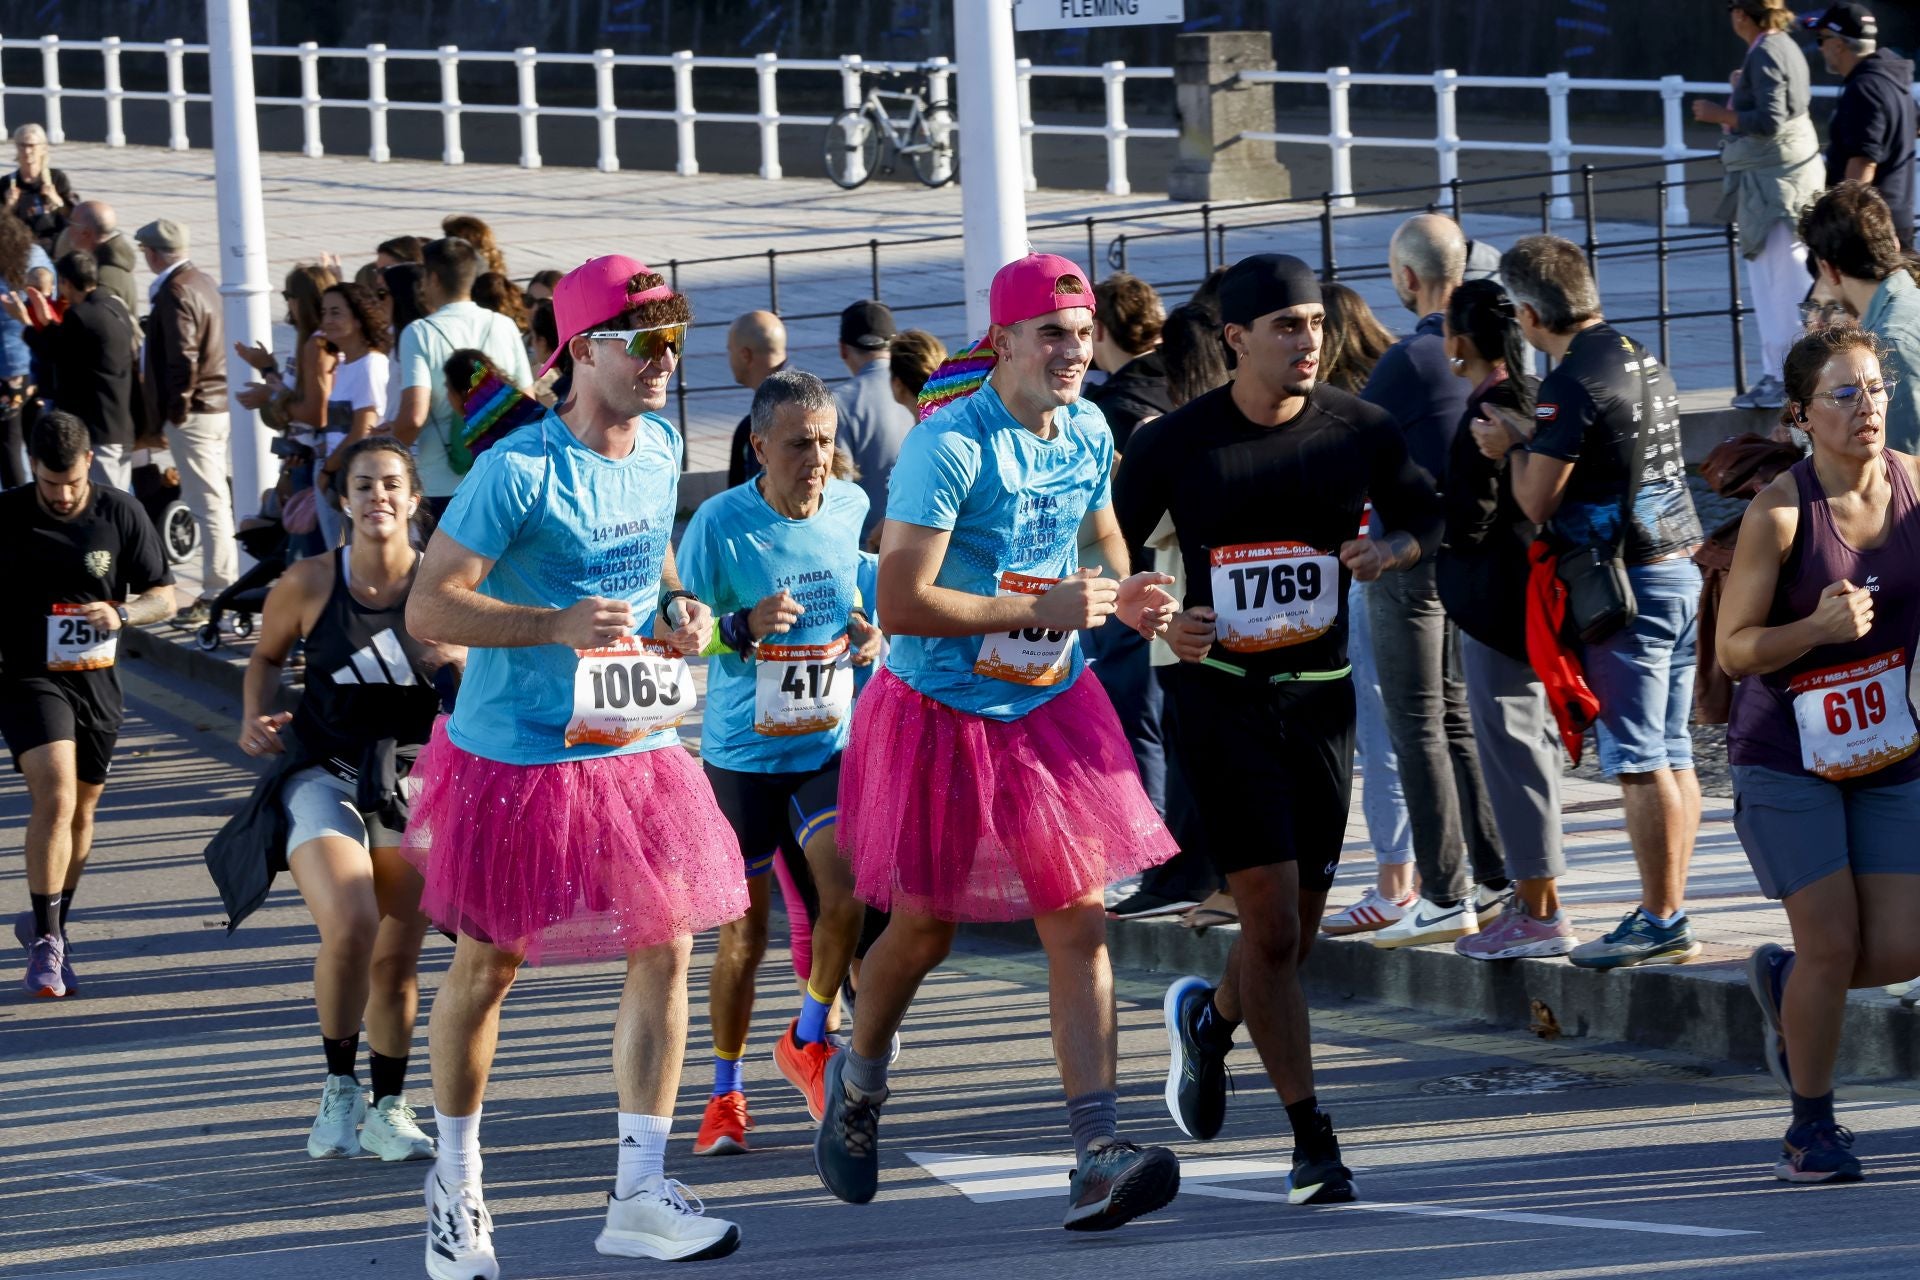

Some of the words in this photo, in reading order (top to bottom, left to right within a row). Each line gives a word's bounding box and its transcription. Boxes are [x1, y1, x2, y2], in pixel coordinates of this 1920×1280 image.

[1060, 0, 1139, 18] FLEMING
[614, 518, 650, 538] MBA
[605, 539, 651, 560] media
[1248, 548, 1273, 558] MBA
[587, 554, 650, 576] maratón
[600, 571, 649, 593] GIJÓN
[798, 569, 833, 584] MBA
[1228, 562, 1321, 611] 1769
[792, 586, 836, 602] media
[1021, 649, 1041, 657] PABLO
[589, 662, 681, 709] 1065
[781, 661, 837, 699] 417
[1823, 681, 1886, 736] 619
